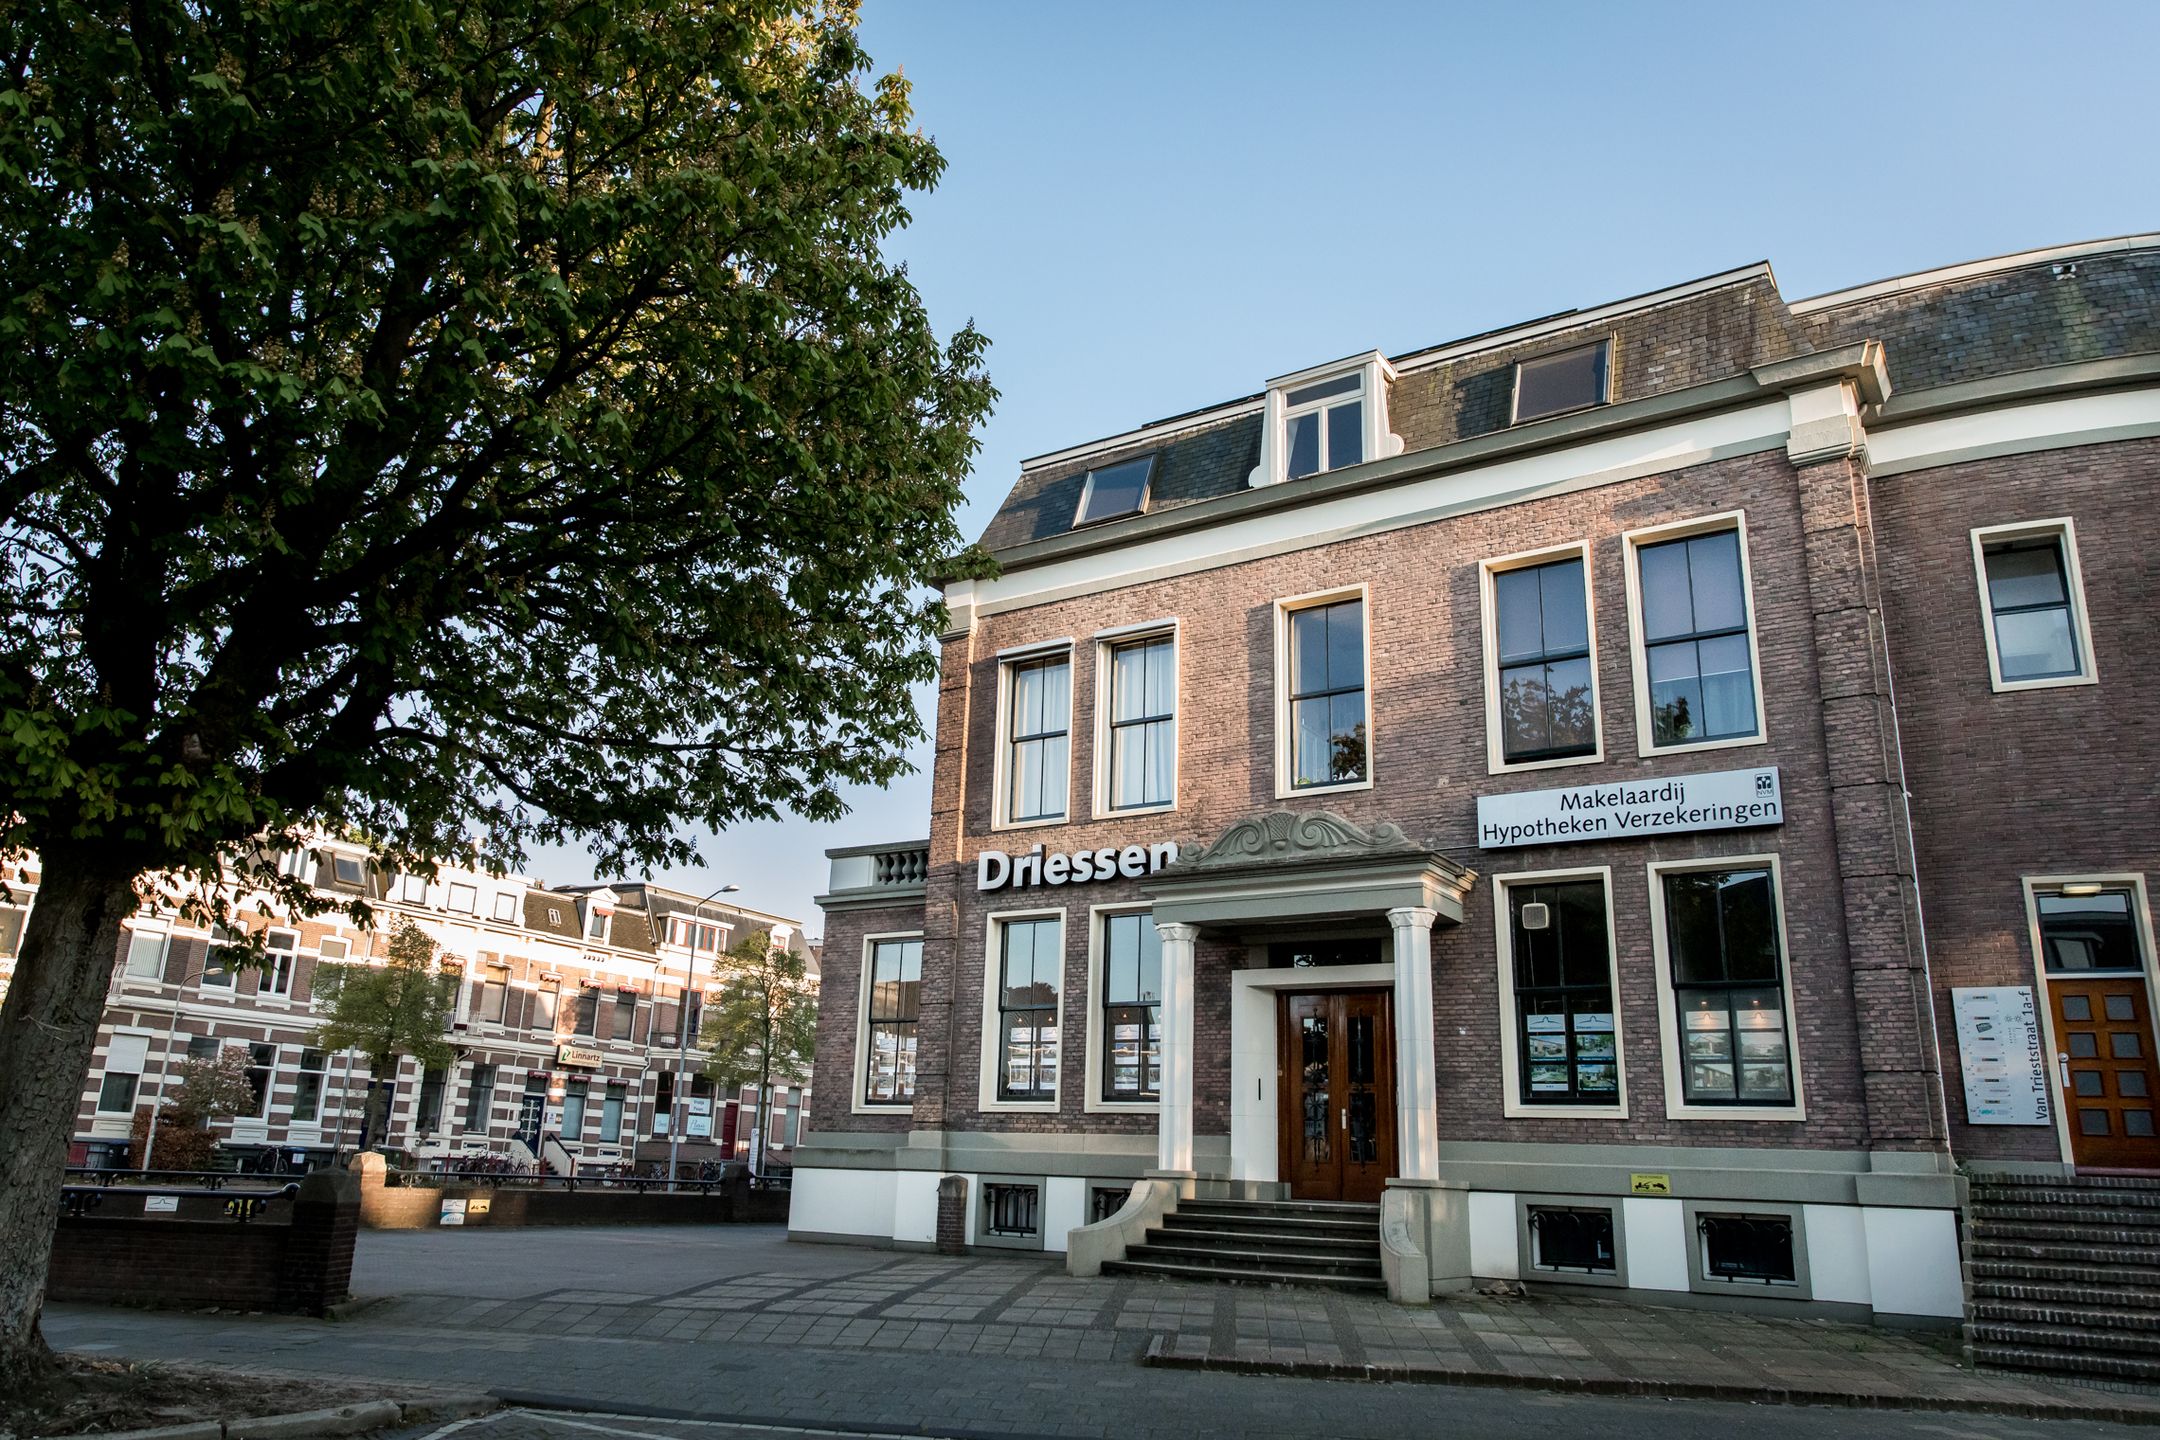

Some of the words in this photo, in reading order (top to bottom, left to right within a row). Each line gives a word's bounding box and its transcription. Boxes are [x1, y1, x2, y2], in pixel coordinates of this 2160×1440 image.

[1560, 782, 1685, 811] Makelaardij
[1483, 815, 1607, 844] Hypotheken
[1614, 802, 1777, 829] Verzekeringen
[977, 841, 1179, 891] Driessen
[2018, 990, 2033, 1016] 1a-f
[571, 1050, 601, 1062] Linnartz
[2023, 1020, 2044, 1092] Trieststraat
[2035, 1097, 2048, 1120] Van
